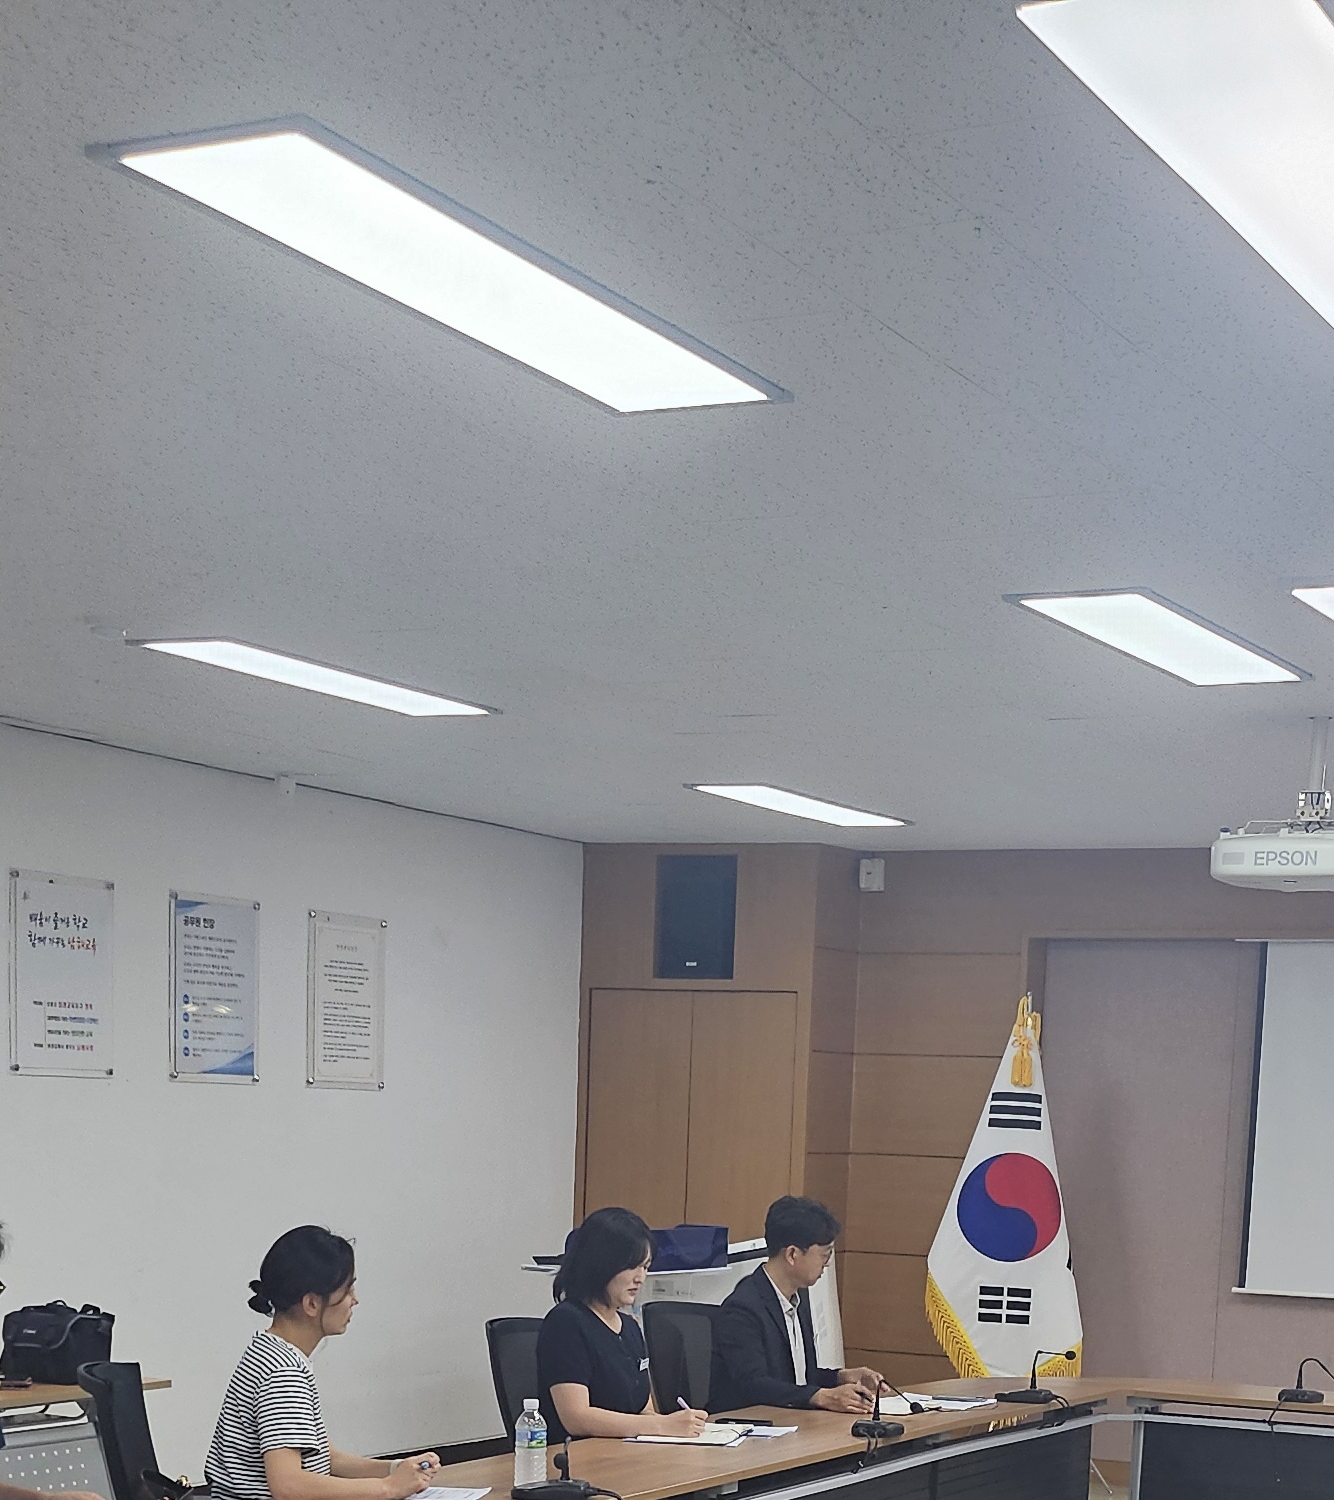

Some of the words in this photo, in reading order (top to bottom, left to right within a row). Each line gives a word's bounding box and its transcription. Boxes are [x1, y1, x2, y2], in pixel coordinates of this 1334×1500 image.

[1254, 850, 1317, 866] EPSON
[72, 914, 88, 931] 학교
[183, 915, 202, 928] 공무원
